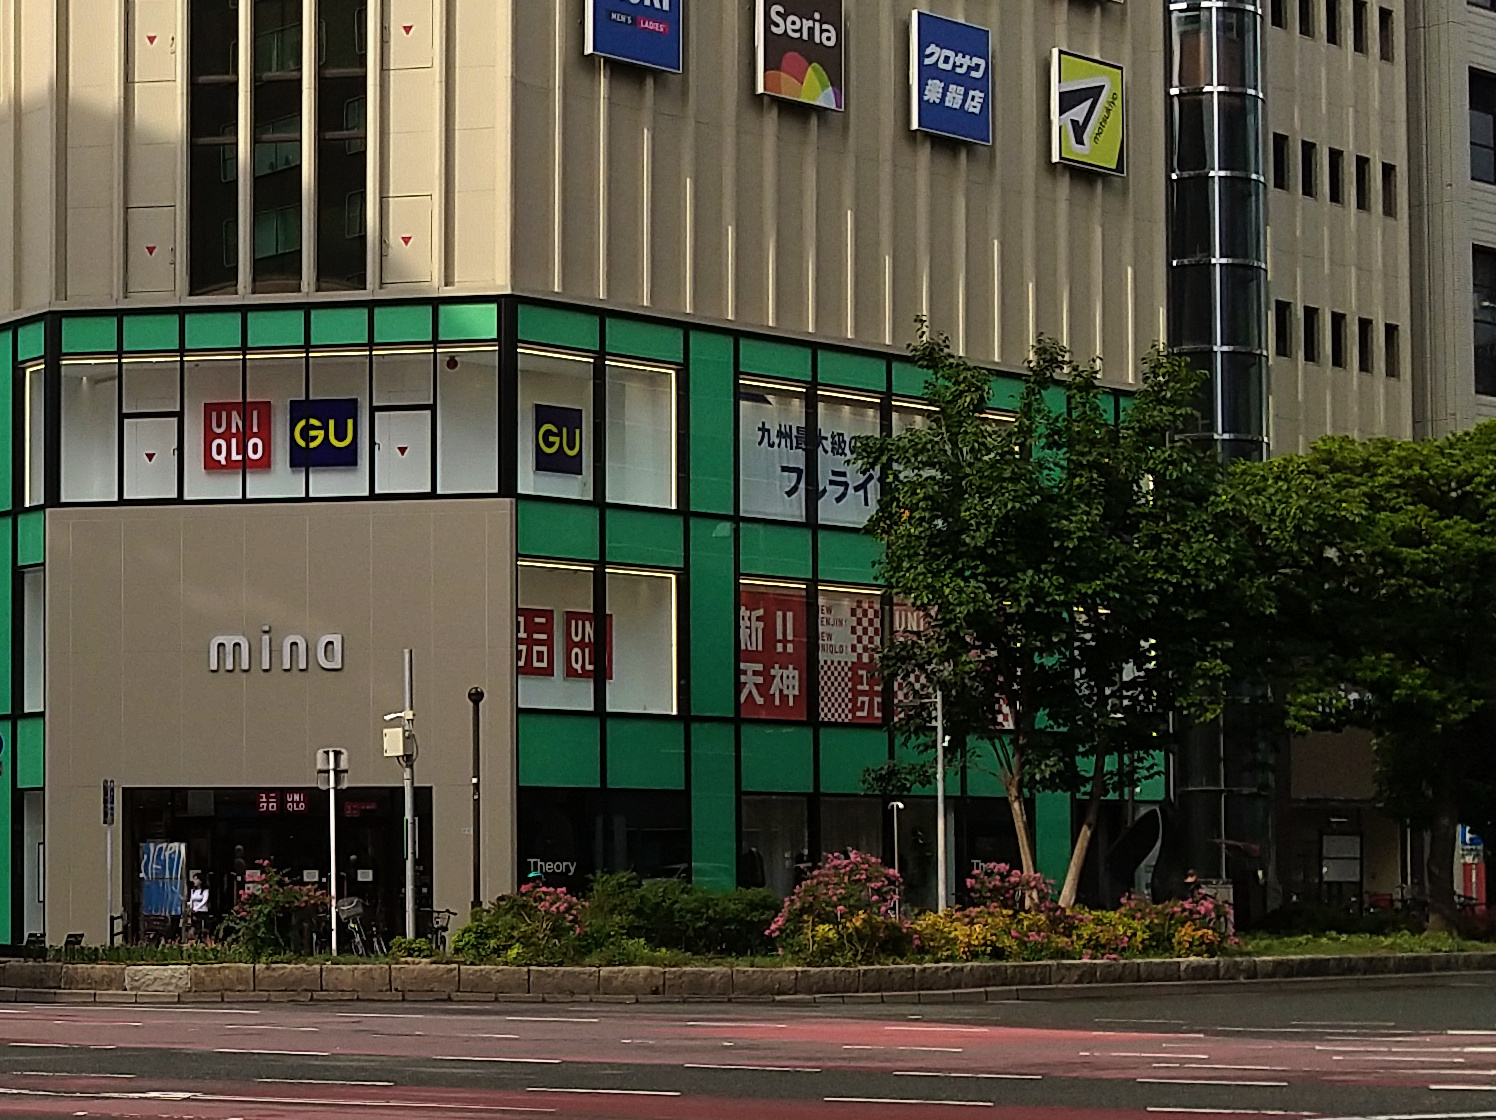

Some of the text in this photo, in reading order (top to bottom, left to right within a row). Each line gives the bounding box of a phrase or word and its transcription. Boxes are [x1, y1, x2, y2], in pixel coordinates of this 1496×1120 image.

[770, 4, 837, 48] Seria
[923, 43, 986, 78] クロサワ
[923, 78, 985, 115] 楽器店
[211, 410, 259, 433] UNI
[294, 418, 353, 449] GU
[538, 423, 580, 456] GU
[211, 438, 263, 465] QLO
[821, 606, 833, 615] EW
[571, 620, 594, 643] UN
[821, 617, 847, 628] ENJIN!
[209, 625, 344, 671] mina
[821, 632, 833, 642] EW
[571, 647, 607, 673] QL
[821, 644, 849, 655] NIQLO!
[740, 662, 799, 707] 天神
[259, 793, 276, 802] ユニ
[287, 793, 303, 801] UNI
[287, 802, 305, 811] QLO
[527, 859, 576, 875] Theory
